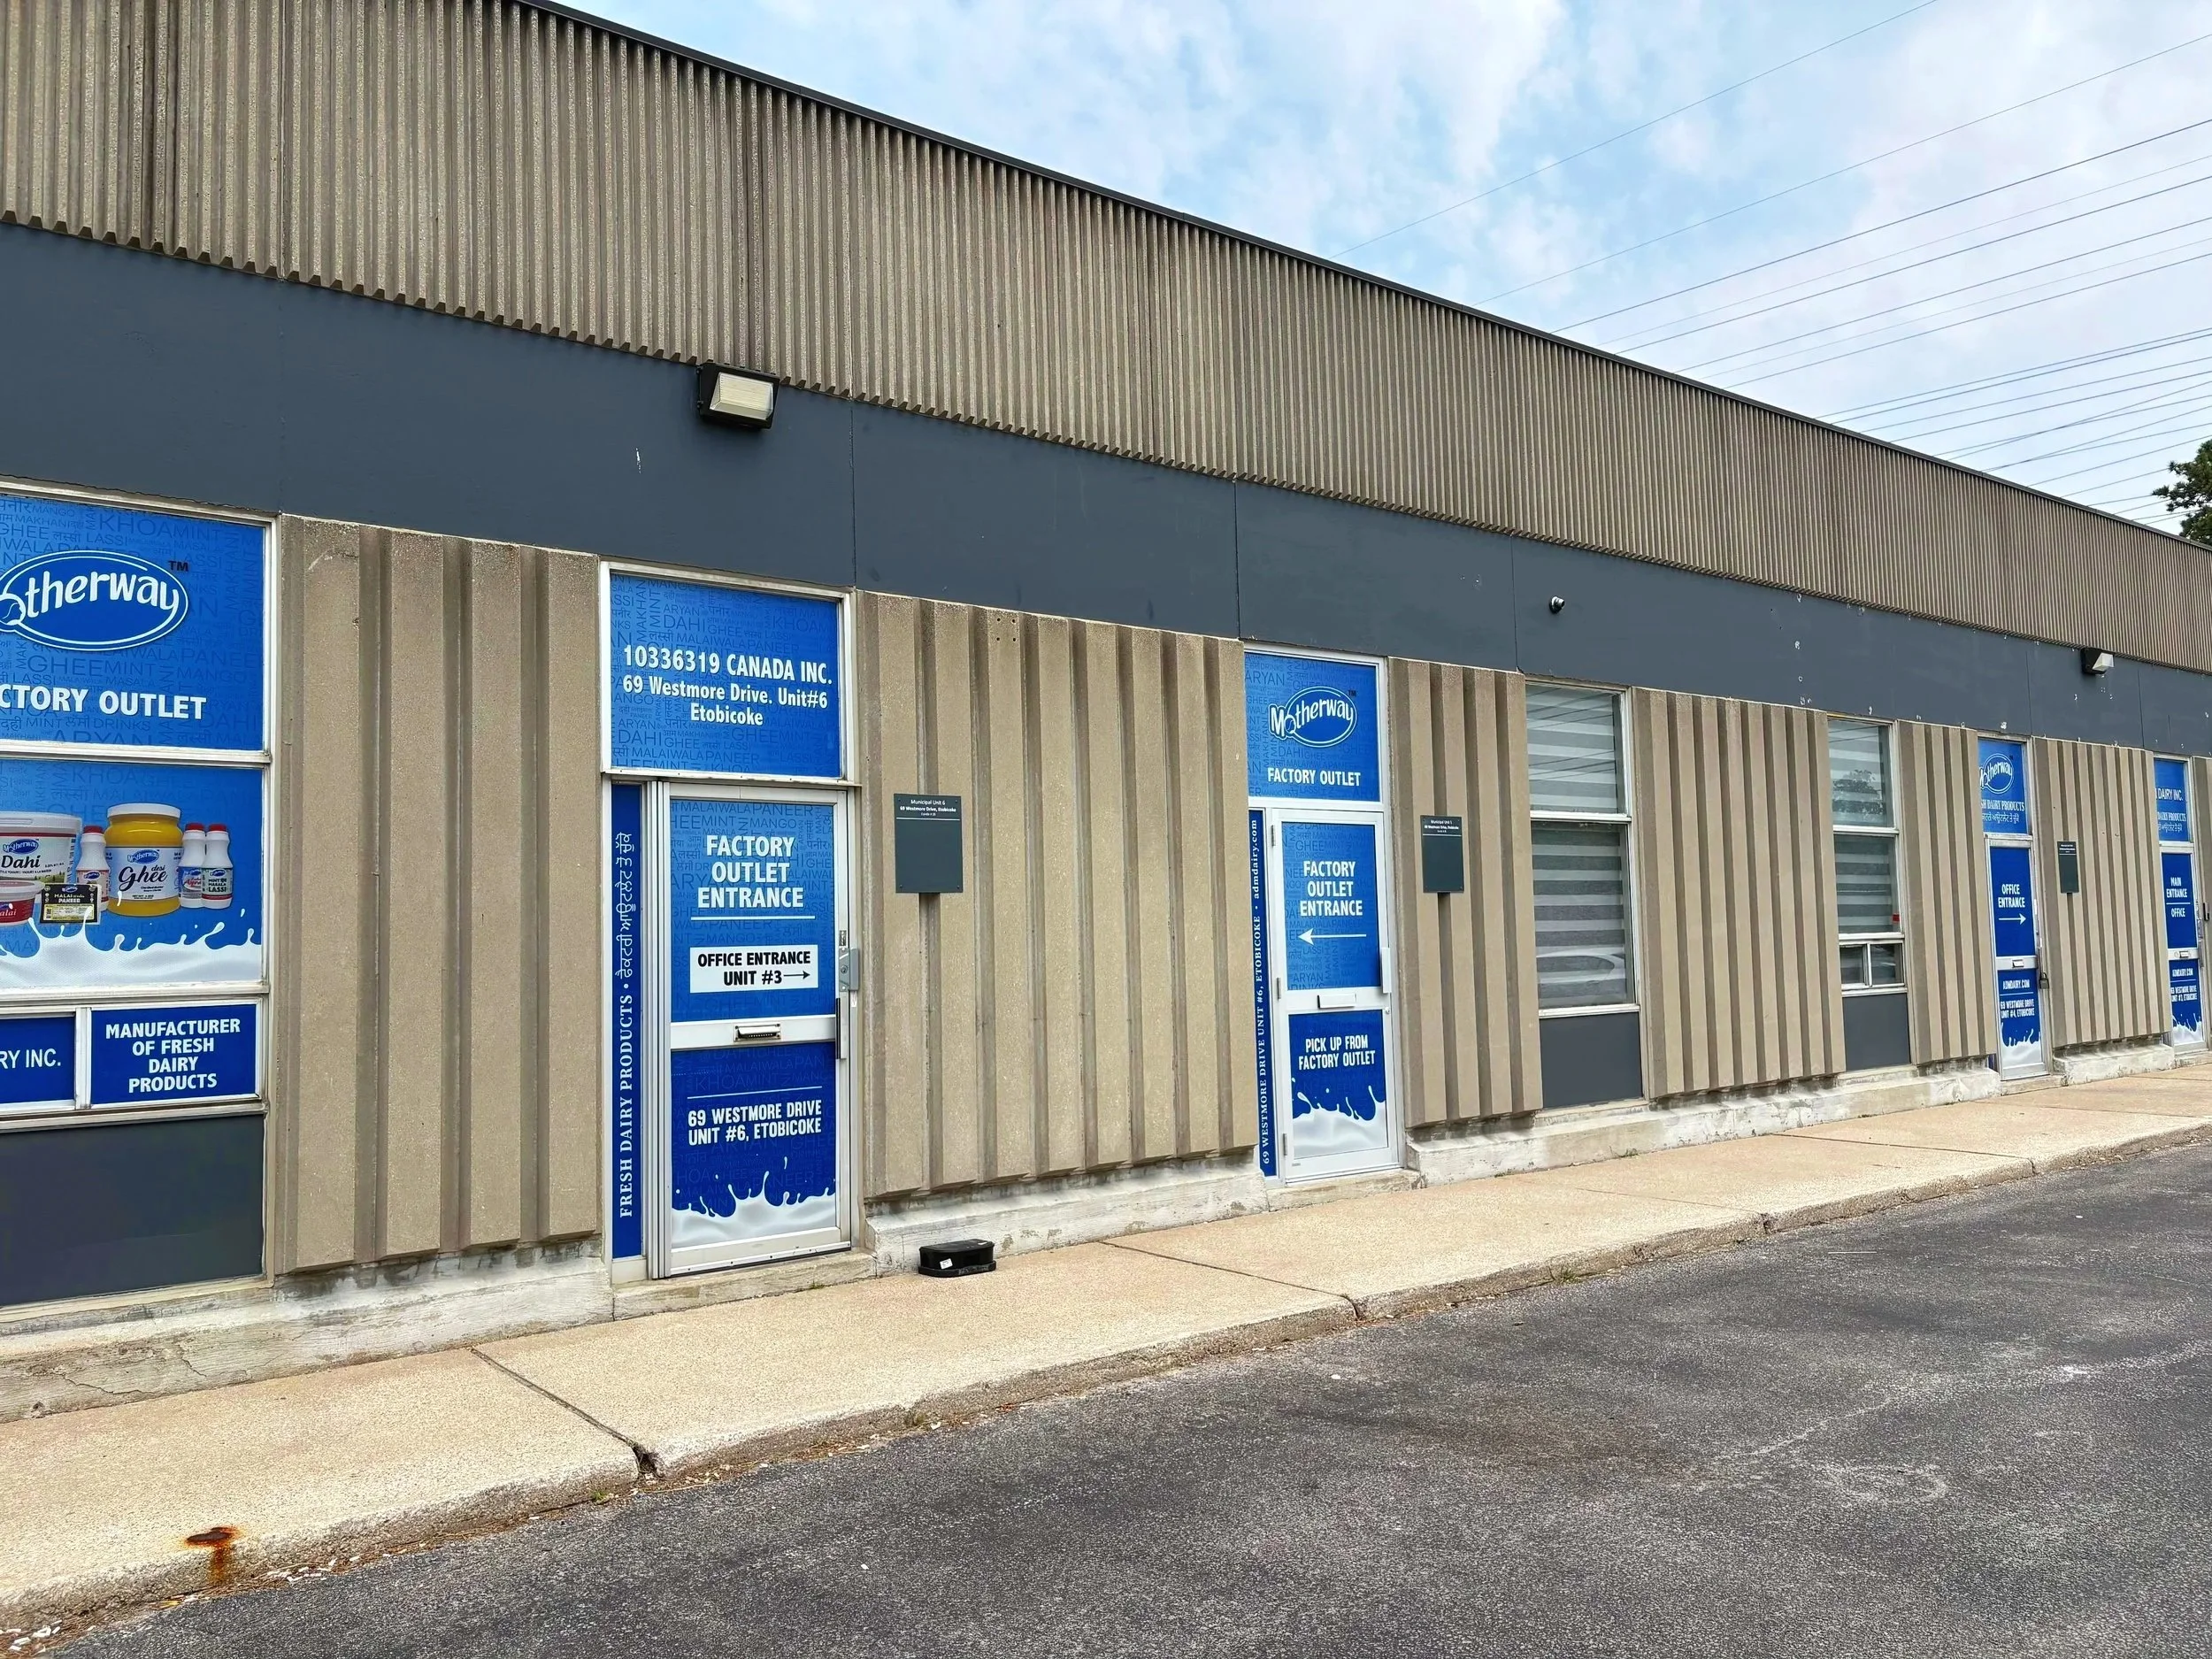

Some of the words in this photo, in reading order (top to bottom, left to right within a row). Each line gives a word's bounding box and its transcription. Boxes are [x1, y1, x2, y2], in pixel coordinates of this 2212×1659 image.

[99, 513, 173, 539] KHOA
[168, 560, 188, 572] TM
[0, 571, 180, 626] otherway
[664, 614, 706, 633] DAHI
[27, 655, 104, 677] GHEE
[624, 644, 720, 674] 10336319
[726, 654, 795, 681] CANADA
[800, 661, 833, 685] INC.
[0, 684, 88, 712] CTORY
[99, 689, 207, 720] OUTLET
[623, 675, 644, 694] 69
[649, 675, 726, 700] Westmore
[730, 684, 773, 704] Drive.
[778, 687, 828, 709] Unit#6
[690, 703, 764, 726] Etobicoke
[1271, 699, 1354, 737] Motherway
[618, 730, 662, 747] DAHI
[632, 747, 705, 763] MALAIWALA
[1267, 767, 1317, 785] FACTORY
[1319, 770, 1361, 787] OUTLET
[2157, 787, 2173, 800] DAIRY
[680, 803, 752, 815] MALAIWALA
[752, 804, 813, 817] PANEER
[2001, 800, 2024, 811] PRODUCTS
[706, 835, 795, 857] FACTORY
[1, 855, 42, 869] Dahi
[1250, 819, 1260, 899] admdairy.com
[1303, 861, 1356, 878] FACTORY
[118, 865, 168, 892] Ghee
[711, 862, 790, 883] OUTLET
[2170, 877, 2182, 887] MAIN
[697, 887, 804, 909] ENTRANCE
[1307, 880, 1354, 897] OUTLET
[2001, 883, 2020, 895] OFFICE
[2166, 888, 2187, 898] ENTRANCE
[1300, 900, 1363, 917] ENTRANCE
[1998, 896, 2025, 909] ENTRANCE
[2170, 908, 2185, 918] OFFICE
[697, 952, 742, 967] OFFICE
[746, 950, 811, 965] ENTRANCE
[1253, 916, 1263, 983] ETOBICOKE
[723, 971, 757, 986] UNIT
[762, 970, 783, 985] #3
[105, 1018, 241, 1040] MANUFACTURER
[132, 1041, 155, 1056] OF
[160, 1037, 215, 1055] FRESH
[619, 995, 634, 1091] PRODUCTS
[1305, 1037, 1327, 1053] PICK
[1330, 1036, 1342, 1050] UP
[1345, 1034, 1368, 1050] FROM
[0, 1050, 20, 1069] RY
[26, 1048, 62, 1068] INC.
[149, 1056, 199, 1073] DAIRY
[1258, 1040, 1267, 1077] DRIVE
[1298, 1053, 1340, 1071] FACTORY
[1342, 1050, 1376, 1067] OUTLET
[128, 1073, 218, 1094] PRODUCTS
[687, 1110, 706, 1127] 69
[711, 1102, 782, 1125] WESTMORE
[786, 1100, 822, 1118] DRIVE
[1259, 1079, 1270, 1150] WESTMORE
[619, 1097, 634, 1152] DAIRY
[688, 1127, 720, 1146] UNIT
[725, 1125, 749, 1142] #6,
[754, 1118, 822, 1140] ETOBICOKE
[1263, 1151, 1270, 1164] 69
[619, 1157, 634, 1218] FRESH
